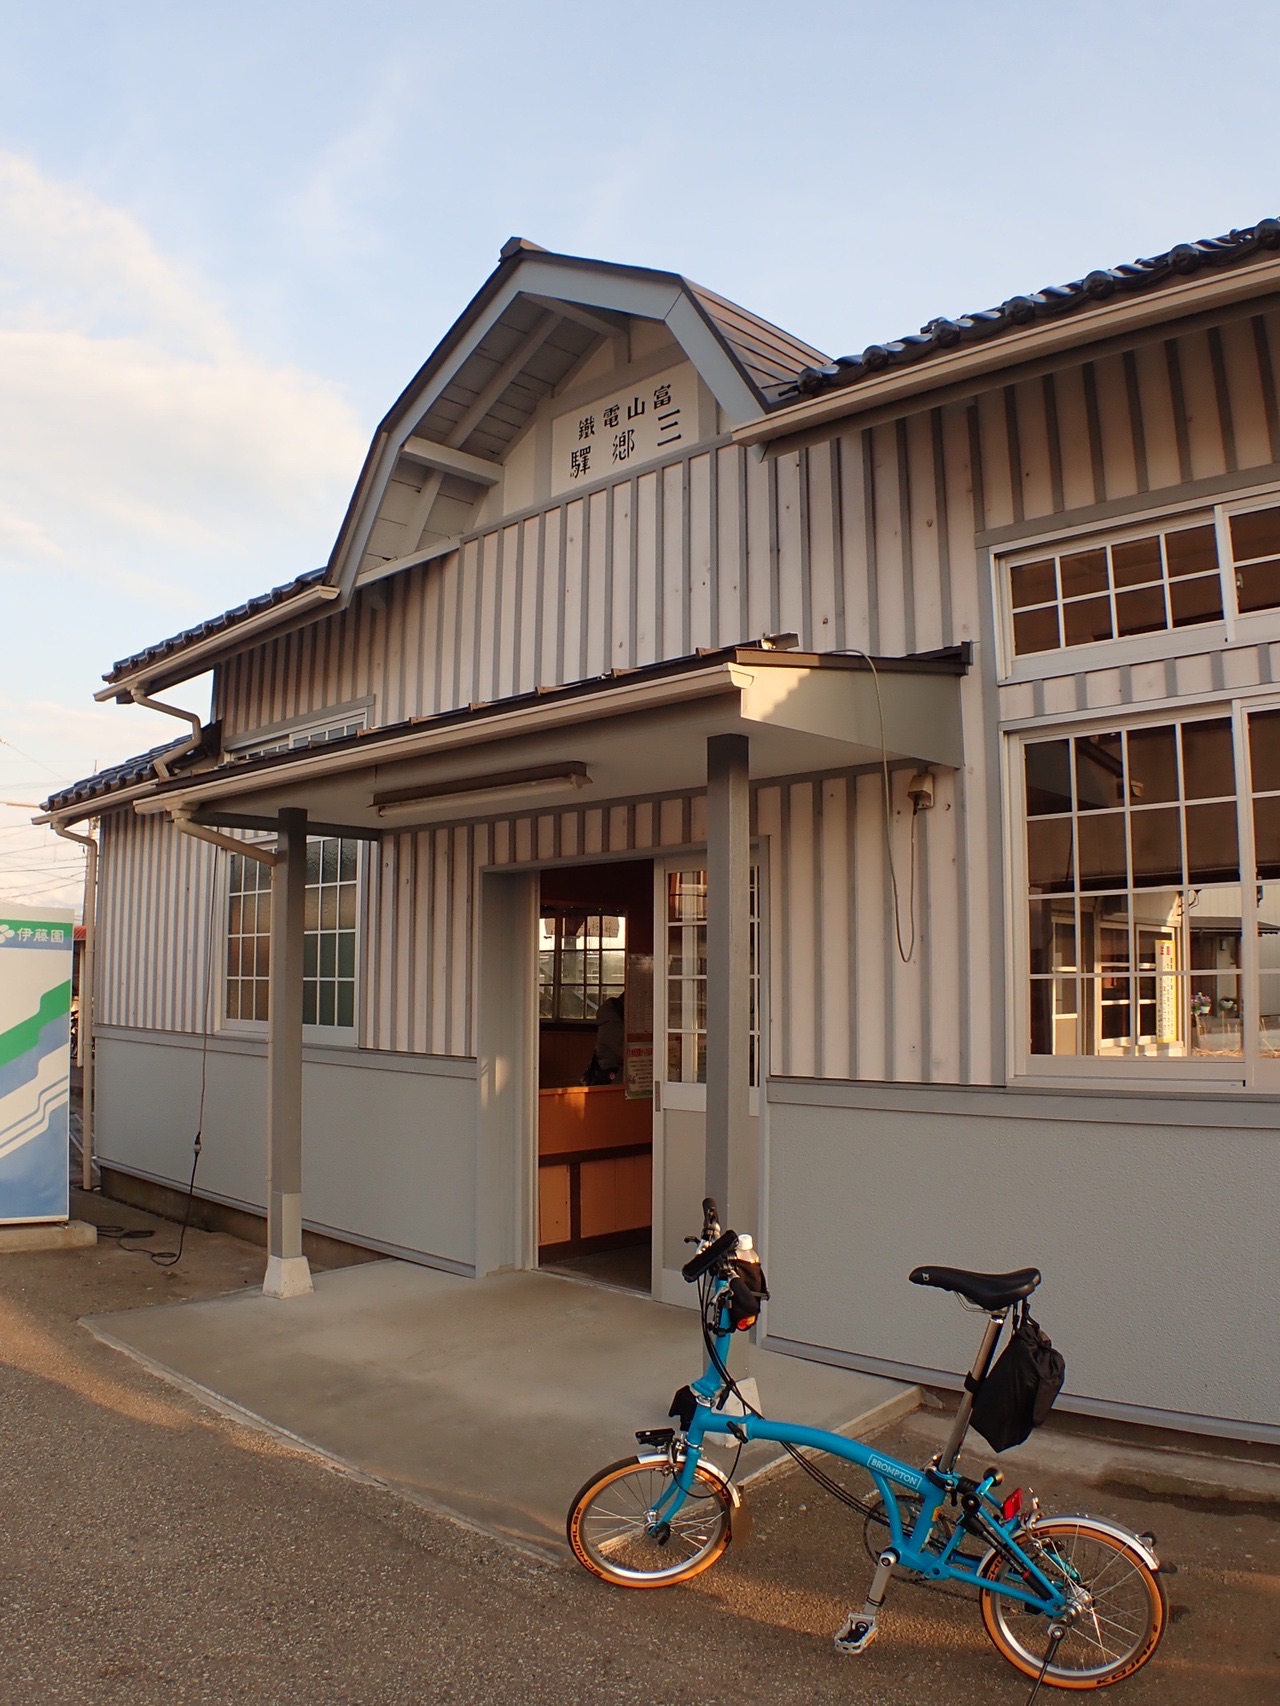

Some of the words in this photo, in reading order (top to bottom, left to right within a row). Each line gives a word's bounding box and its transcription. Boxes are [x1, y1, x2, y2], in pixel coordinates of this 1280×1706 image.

[17, 927, 64, 943] 伊藤園
[871, 1458, 918, 1485] BROMPTON
[1096, 1637, 1154, 1685] KOJAK
